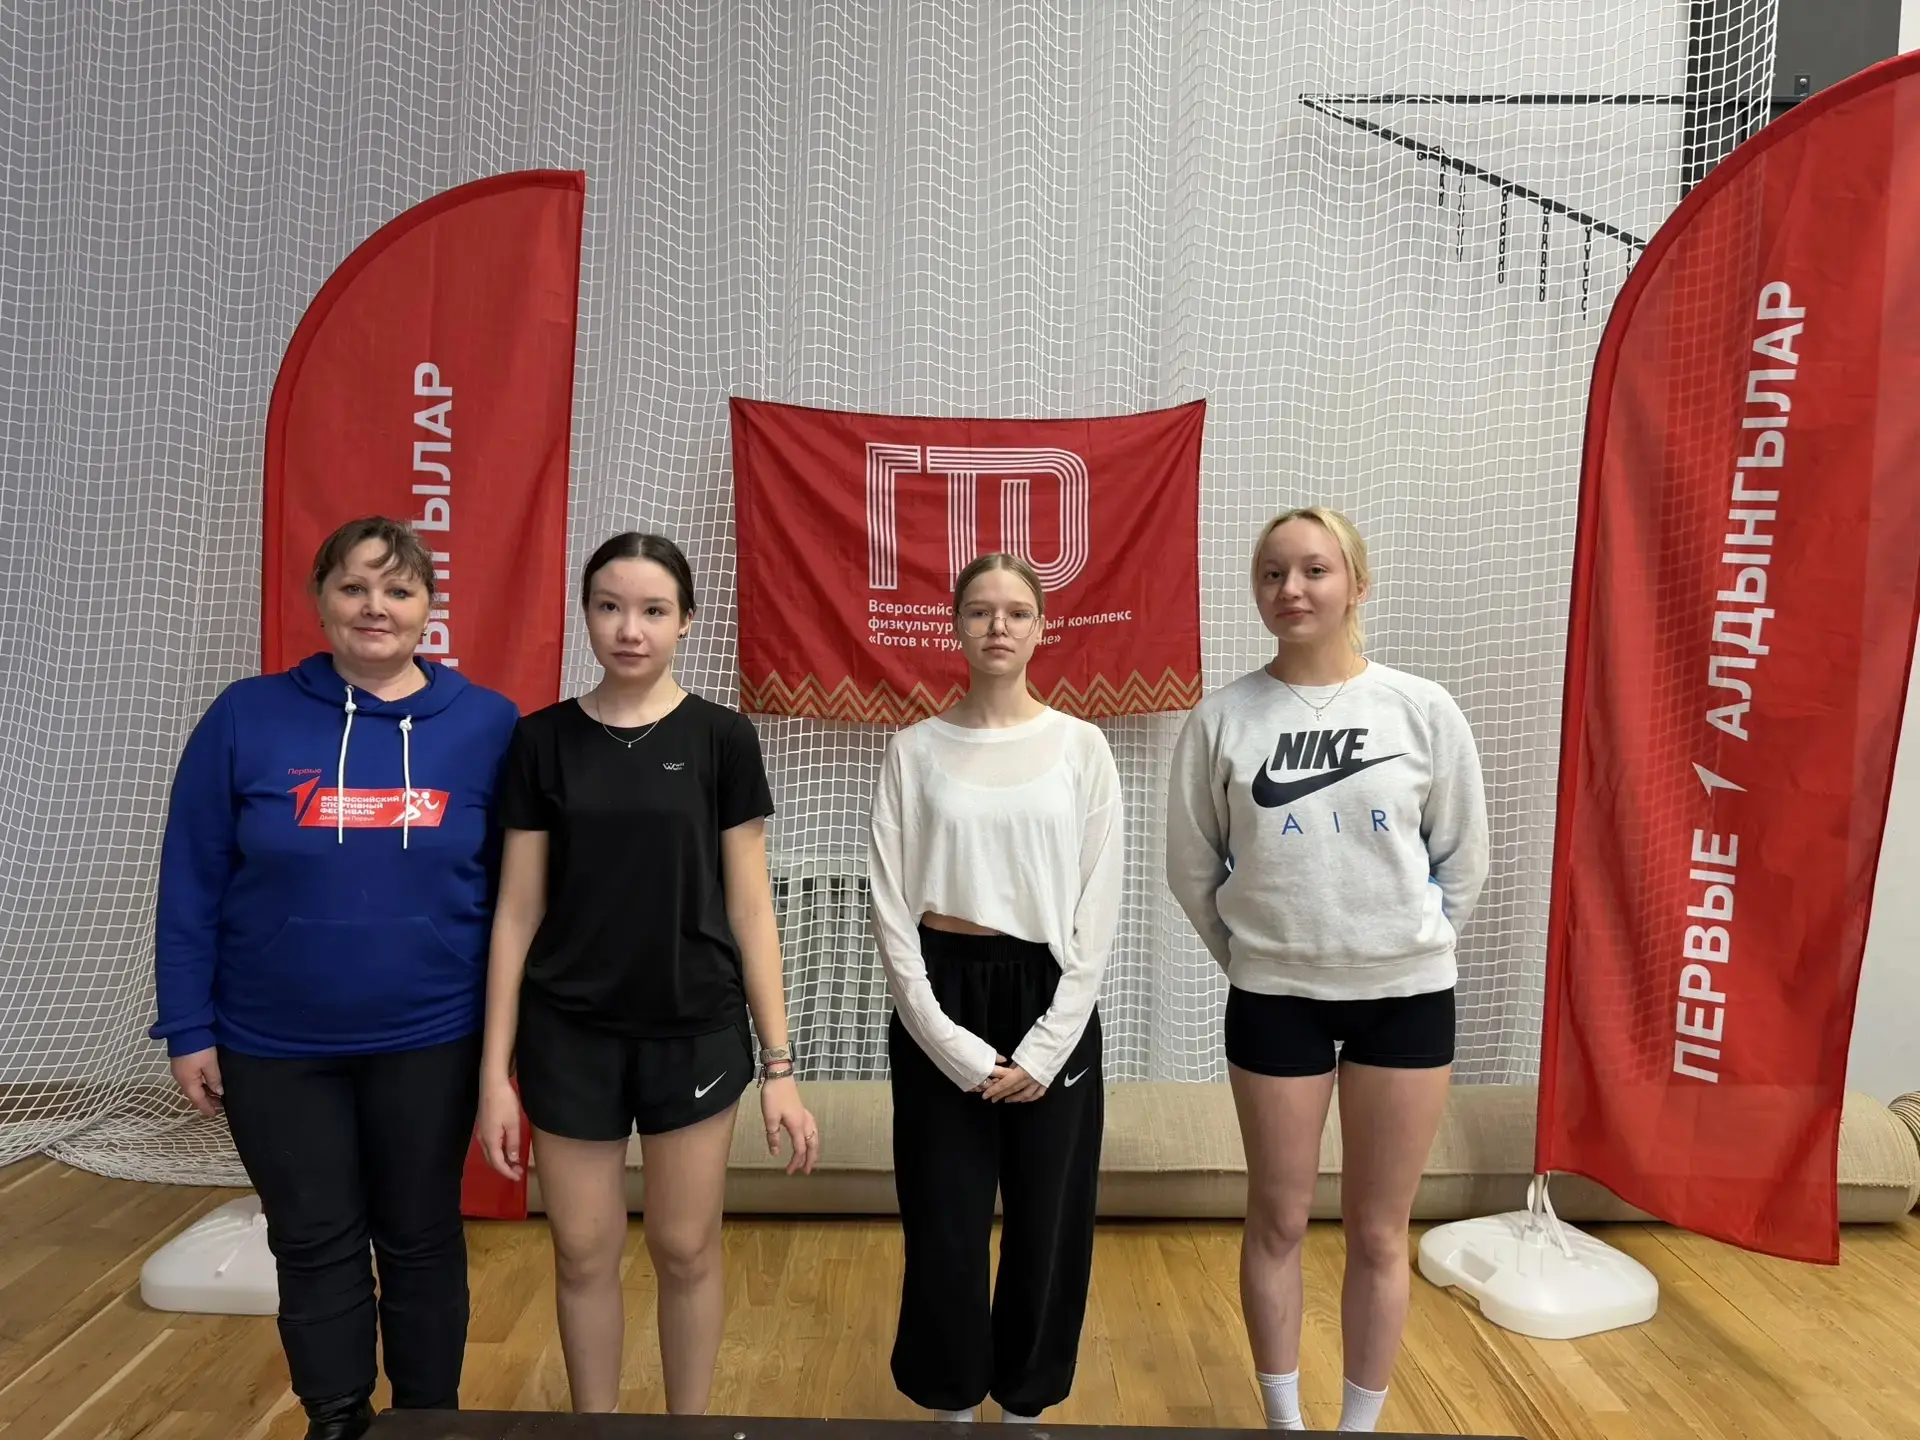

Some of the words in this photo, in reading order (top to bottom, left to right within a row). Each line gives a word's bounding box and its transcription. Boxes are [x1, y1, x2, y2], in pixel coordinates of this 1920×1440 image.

[865, 442, 1090, 592] ГТО
[868, 599, 954, 617] Всероссийс
[1067, 610, 1132, 628] комплекс
[868, 632, 917, 648] «Готов
[921, 637, 930, 648] к
[1673, 829, 1739, 1084] ПЕРВЫЕ
[1706, 281, 1807, 742] АЛДЫНГЫЛАР
[1270, 727, 1369, 772] NIKE
[1281, 809, 1390, 836] AIR
